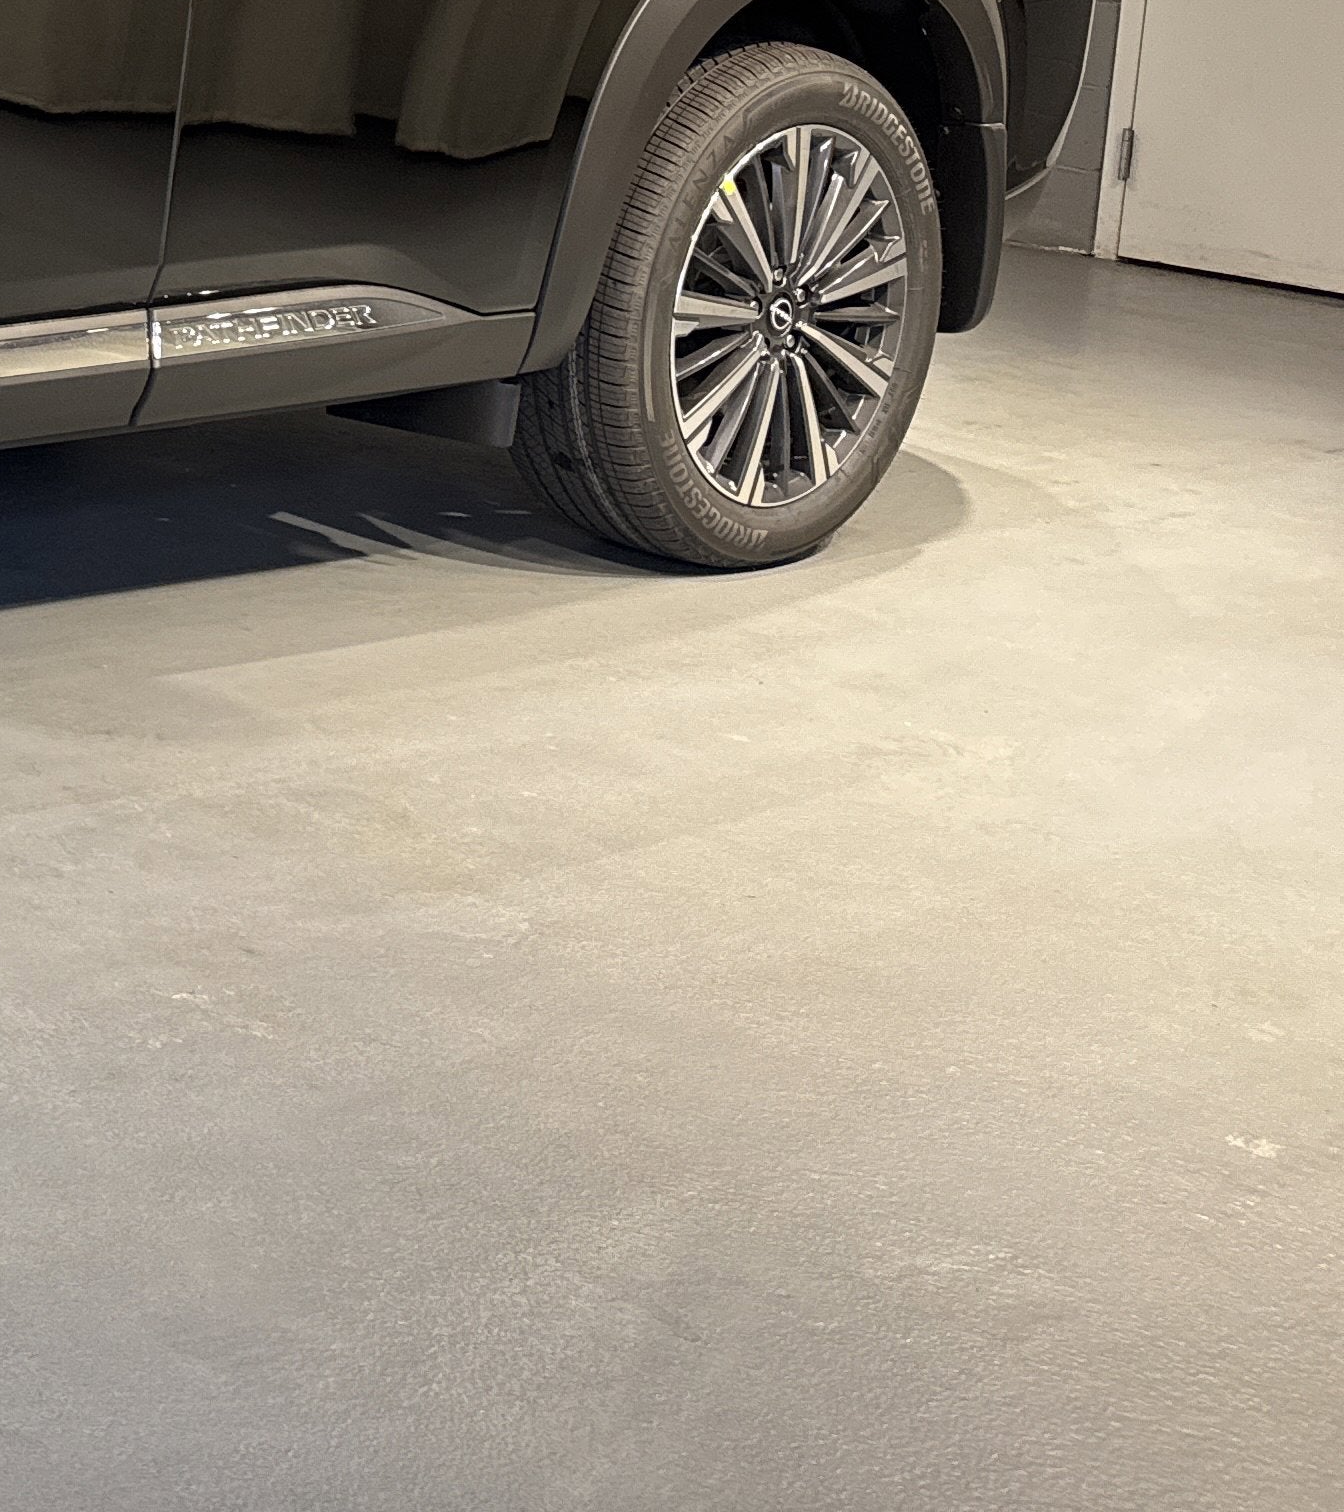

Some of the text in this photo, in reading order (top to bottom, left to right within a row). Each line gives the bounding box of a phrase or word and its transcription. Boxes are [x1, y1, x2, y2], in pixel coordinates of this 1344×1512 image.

[838, 81, 935, 215] BRIDGESTONE
[169, 304, 377, 350] PATHFINDER
[659, 428, 770, 549] BRIDGESTONE
